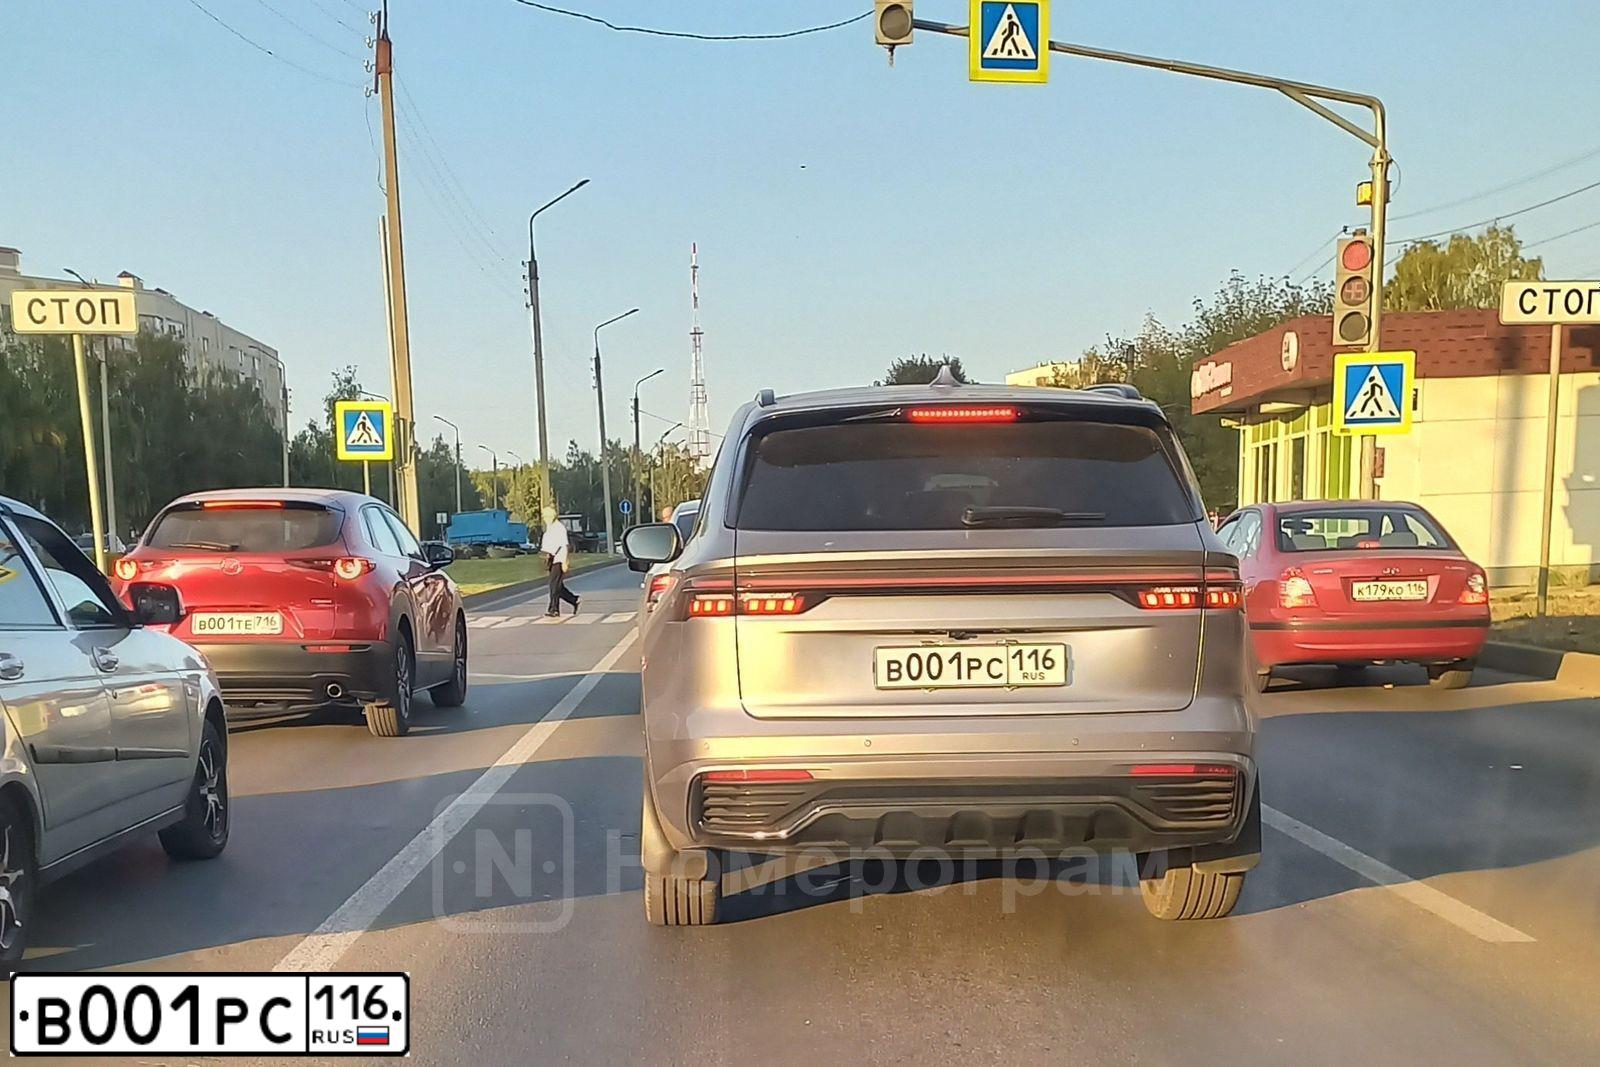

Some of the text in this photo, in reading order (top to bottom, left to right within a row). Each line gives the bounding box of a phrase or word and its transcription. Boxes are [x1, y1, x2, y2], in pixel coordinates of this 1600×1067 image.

[27, 298, 120, 325] СТОП
[1357, 583, 1425, 596] К179КО 116
[199, 616, 277, 630] В001ТЕ 716
[887, 649, 1056, 682] В001РС 116
[1022, 672, 1045, 681] RUS
